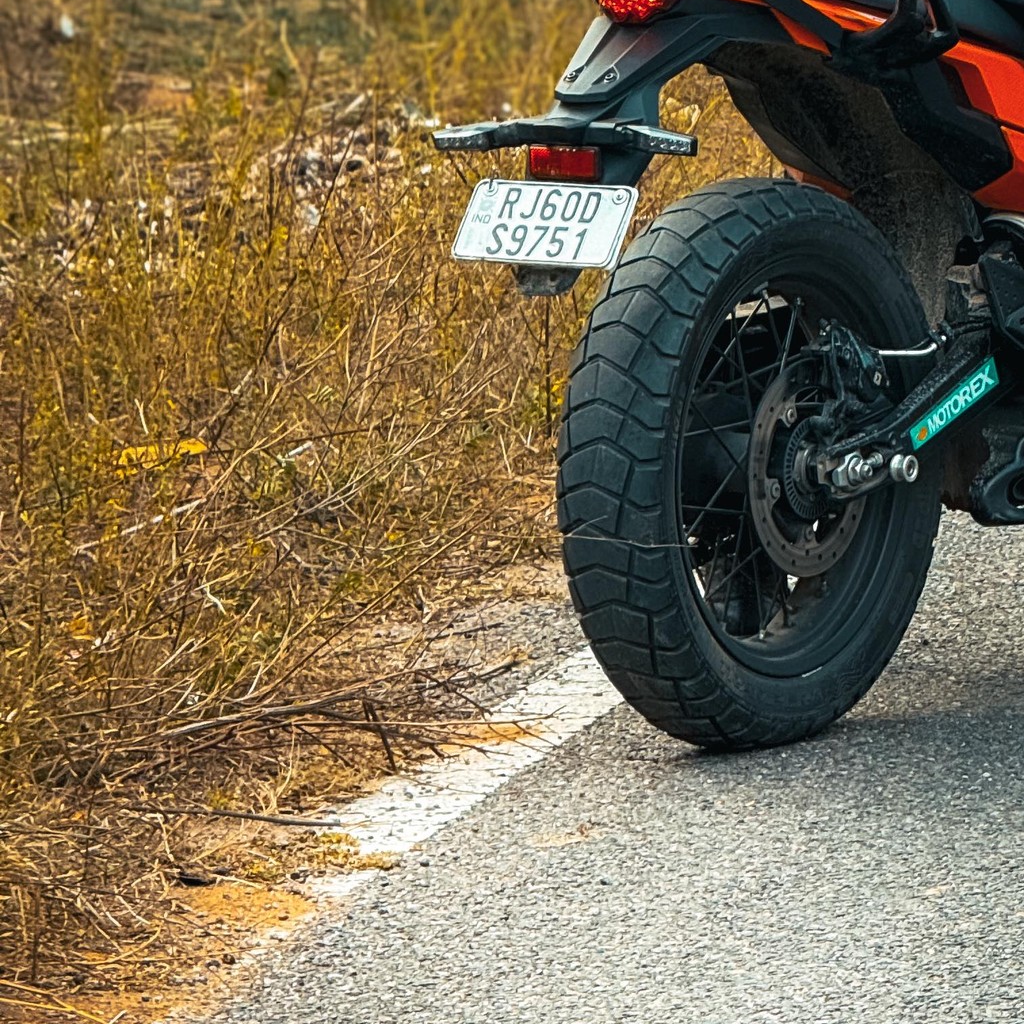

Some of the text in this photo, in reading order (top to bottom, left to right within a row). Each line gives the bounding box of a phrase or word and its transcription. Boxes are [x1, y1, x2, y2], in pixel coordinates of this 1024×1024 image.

[471, 213, 492, 225] IND
[498, 187, 602, 224] RJ60D
[486, 223, 588, 261] S9751
[926, 364, 995, 435] MOTOREX
